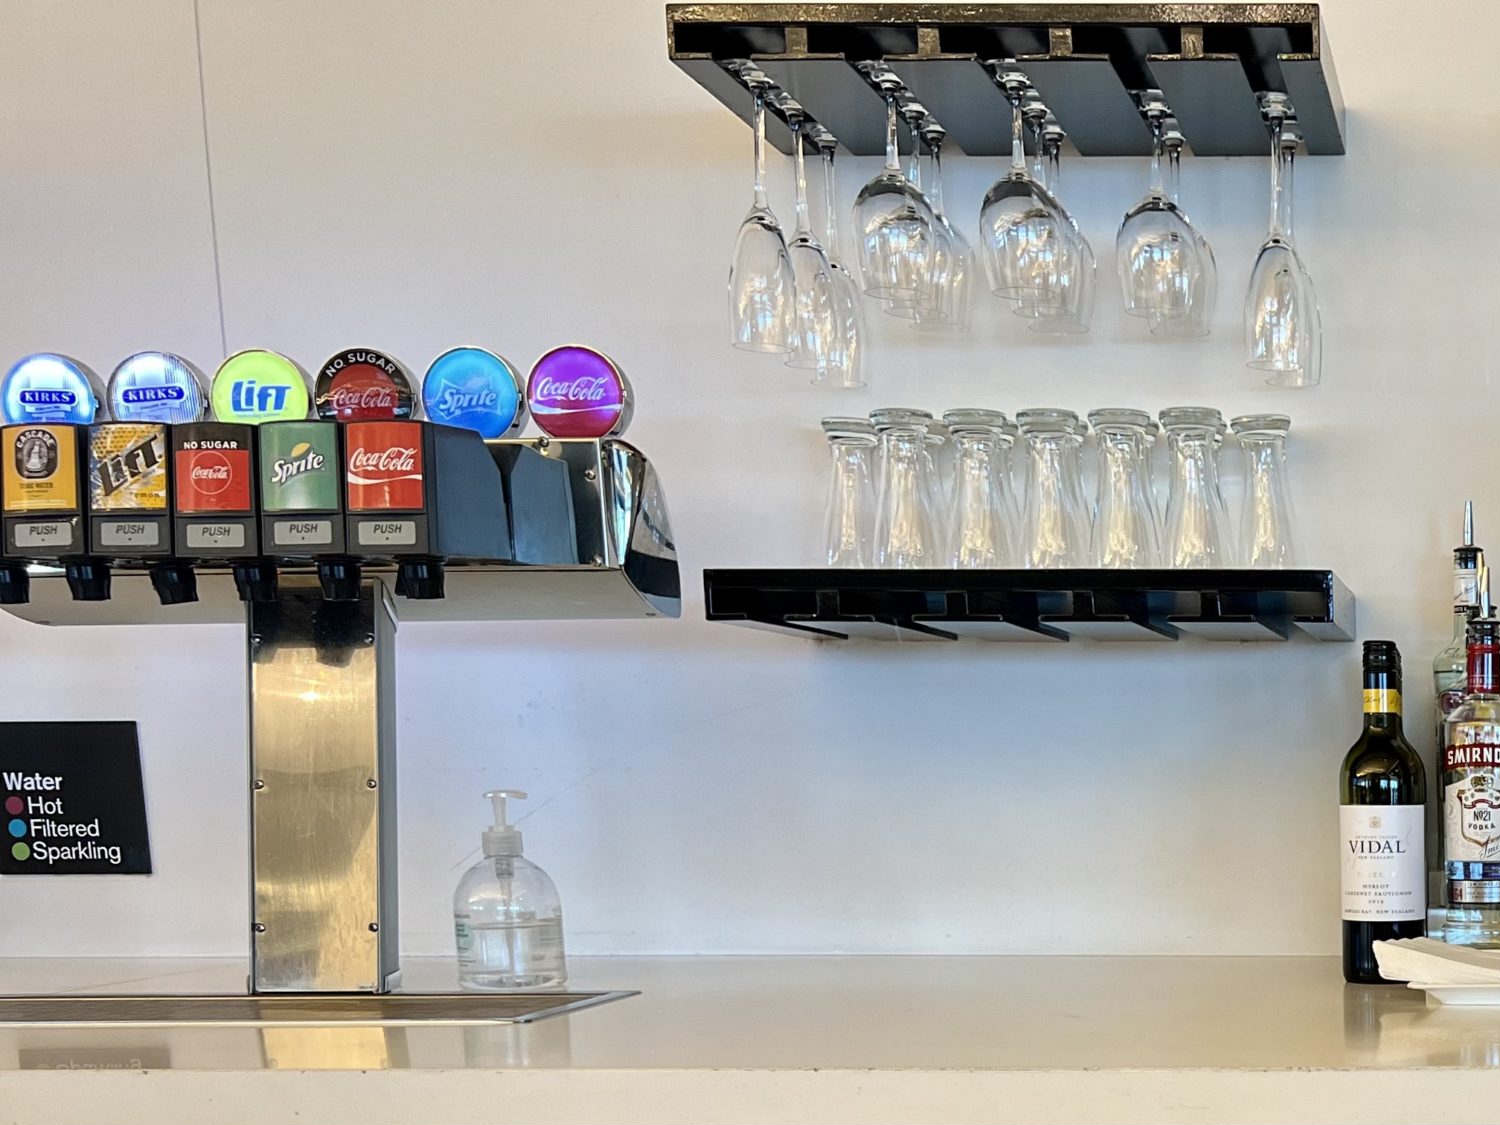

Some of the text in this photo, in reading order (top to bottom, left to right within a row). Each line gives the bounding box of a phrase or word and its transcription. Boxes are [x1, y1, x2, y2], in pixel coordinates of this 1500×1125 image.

[325, 352, 396, 378] NO SUGAR
[127, 387, 178, 401] KIRKS
[536, 376, 609, 401] Coca-Cola
[25, 392, 70, 403] KIRKS
[332, 386, 392, 409] Coca-Cola
[439, 388, 497, 413] Sprite
[16, 430, 56, 449] CASCADE
[183, 440, 238, 450] NO SUGAR
[271, 450, 324, 484] Sprite
[349, 447, 417, 471] Coca-Cola
[192, 465, 229, 480] Coca-Cola
[29, 525, 58, 535] PUSH
[115, 525, 145, 534] PUSH
[201, 526, 231, 537] PUSH
[289, 524, 318, 533] PUSH
[373, 524, 402, 534] PUSH
[2, 771, 63, 791] Water
[27, 796, 64, 815] Hot
[30, 818, 100, 838] Filtered
[1468, 822, 1496, 831] VODKA
[32, 840, 122, 865] Sparkling
[1349, 839, 1407, 854] VIDAL
